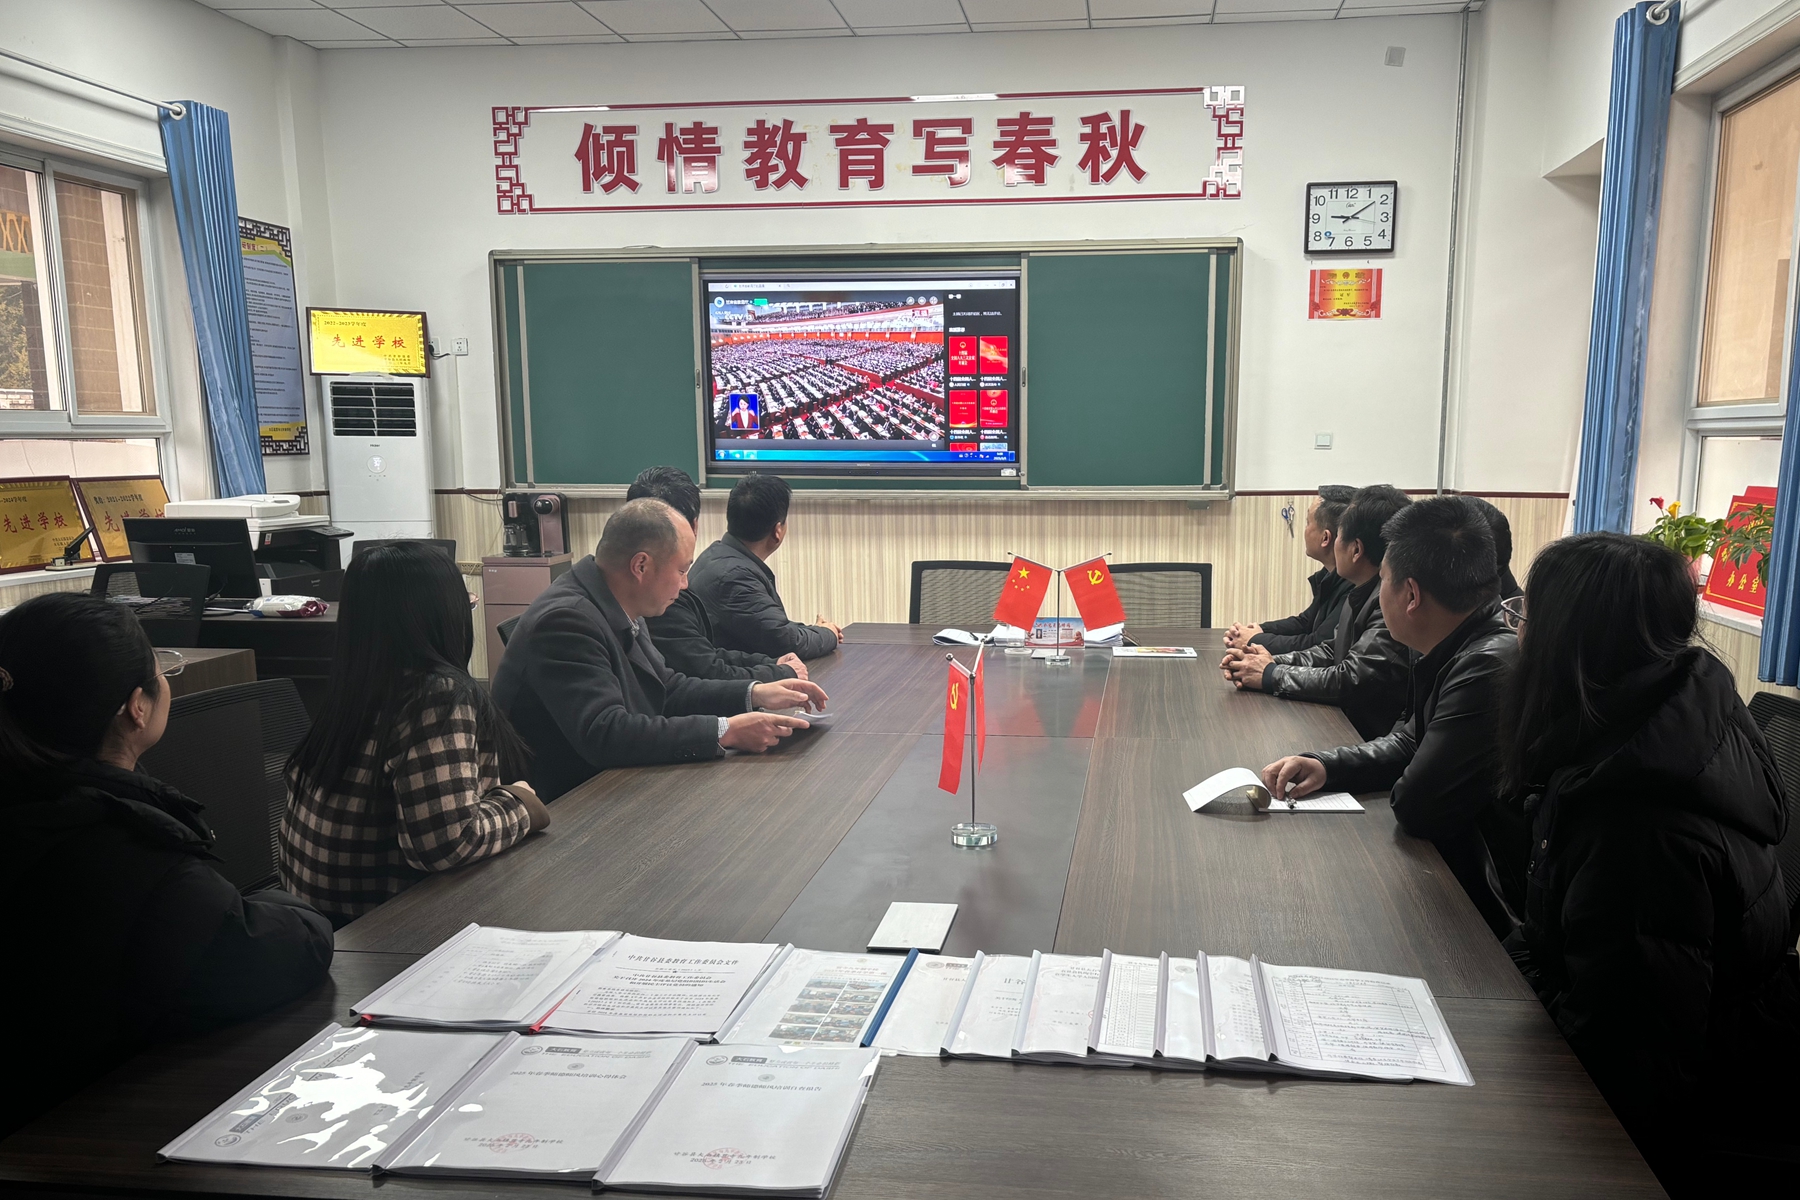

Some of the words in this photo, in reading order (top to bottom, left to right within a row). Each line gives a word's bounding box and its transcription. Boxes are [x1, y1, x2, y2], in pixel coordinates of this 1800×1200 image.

[574, 109, 1150, 194] 倾情教育写春秋
[1328, 188, 1339, 199] 11
[1345, 188, 1359, 199] 12
[1366, 188, 1372, 199] 1
[1314, 195, 1326, 206] 10
[1379, 194, 1389, 205] 2
[1312, 213, 1321, 224] 9
[1380, 211, 1389, 223] 3
[1313, 231, 1322, 241] 8
[1377, 229, 1387, 239] 4
[1328, 236, 1336, 247] 7
[1344, 236, 1354, 247] 6
[1363, 235, 1373, 247] 5
[331, 333, 407, 349] 先进学校
[3, 511, 68, 534] 先进学校
[1726, 570, 1761, 594] 办公室
[627, 954, 740, 966] 中共甘谷县委教育工作委员会文件
